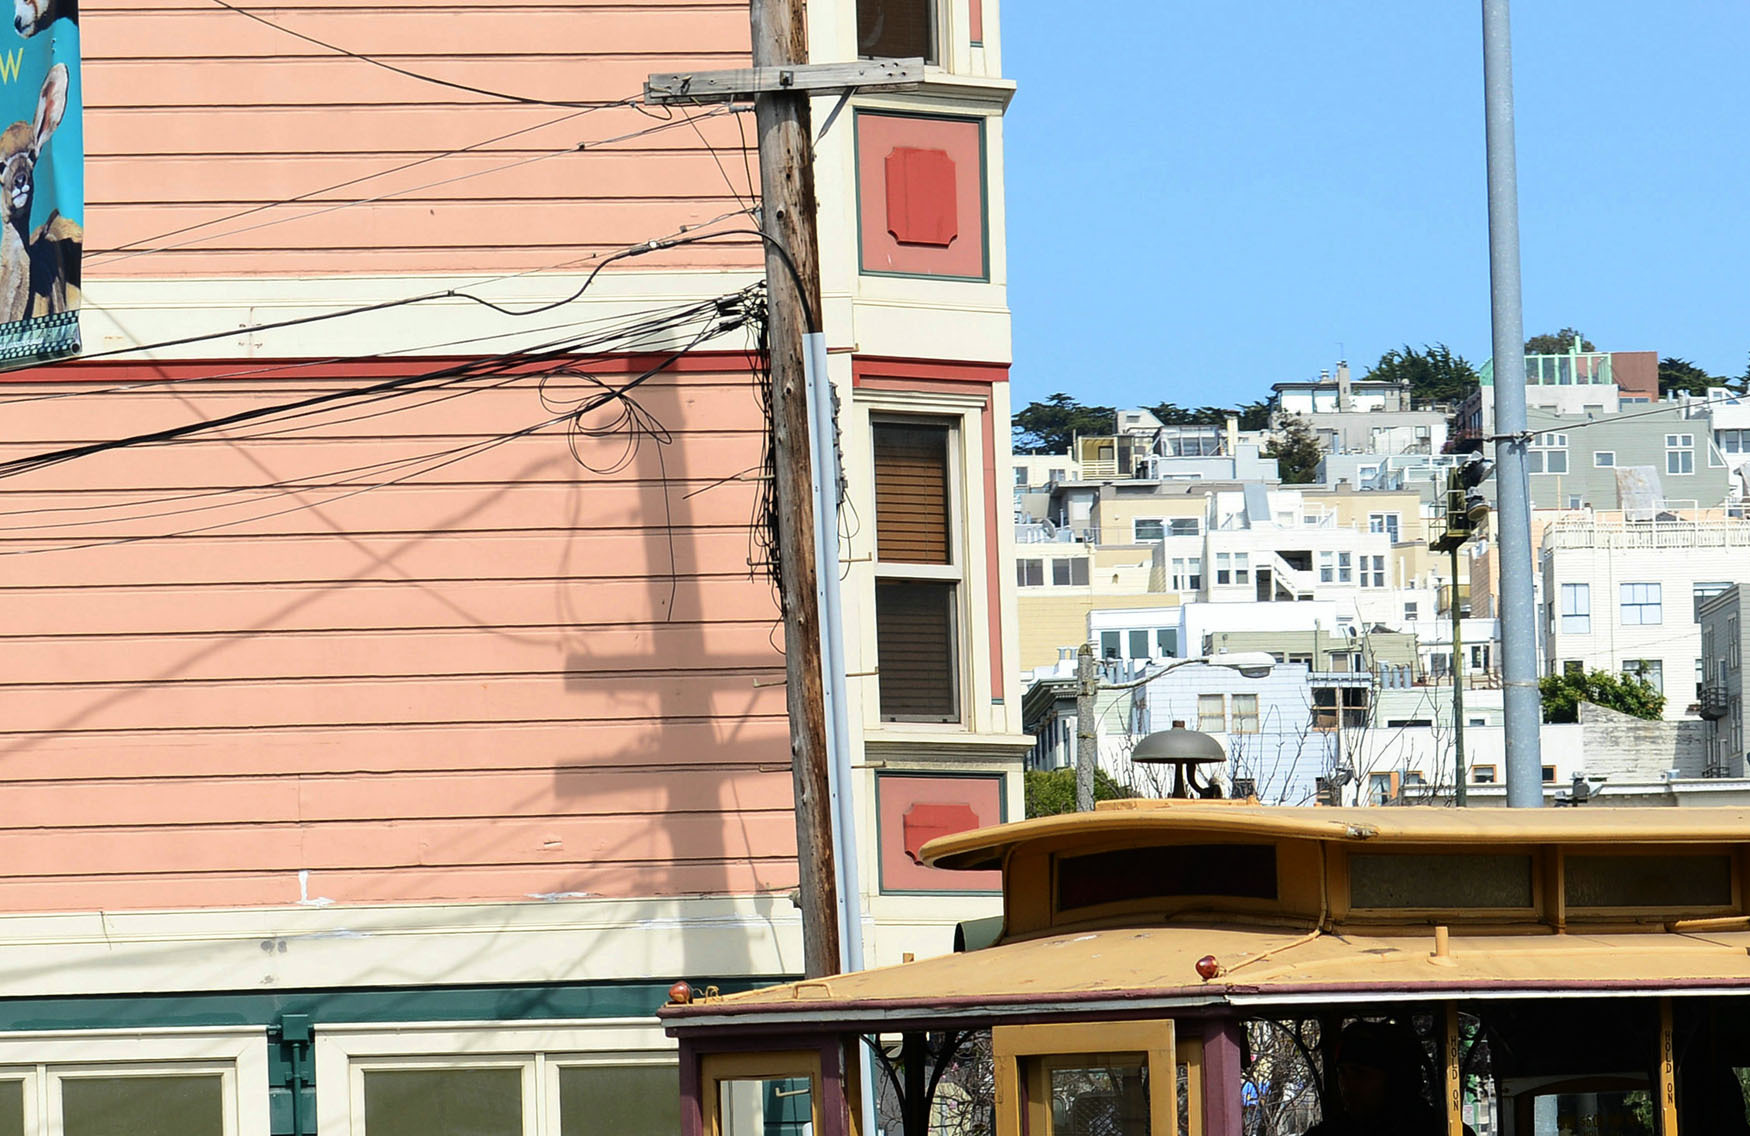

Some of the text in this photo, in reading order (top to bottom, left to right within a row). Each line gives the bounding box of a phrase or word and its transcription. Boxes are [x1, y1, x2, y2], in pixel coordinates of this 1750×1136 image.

[1450, 1035, 1459, 1111] HOLD ON
[1667, 1082, 1673, 1104] ON
